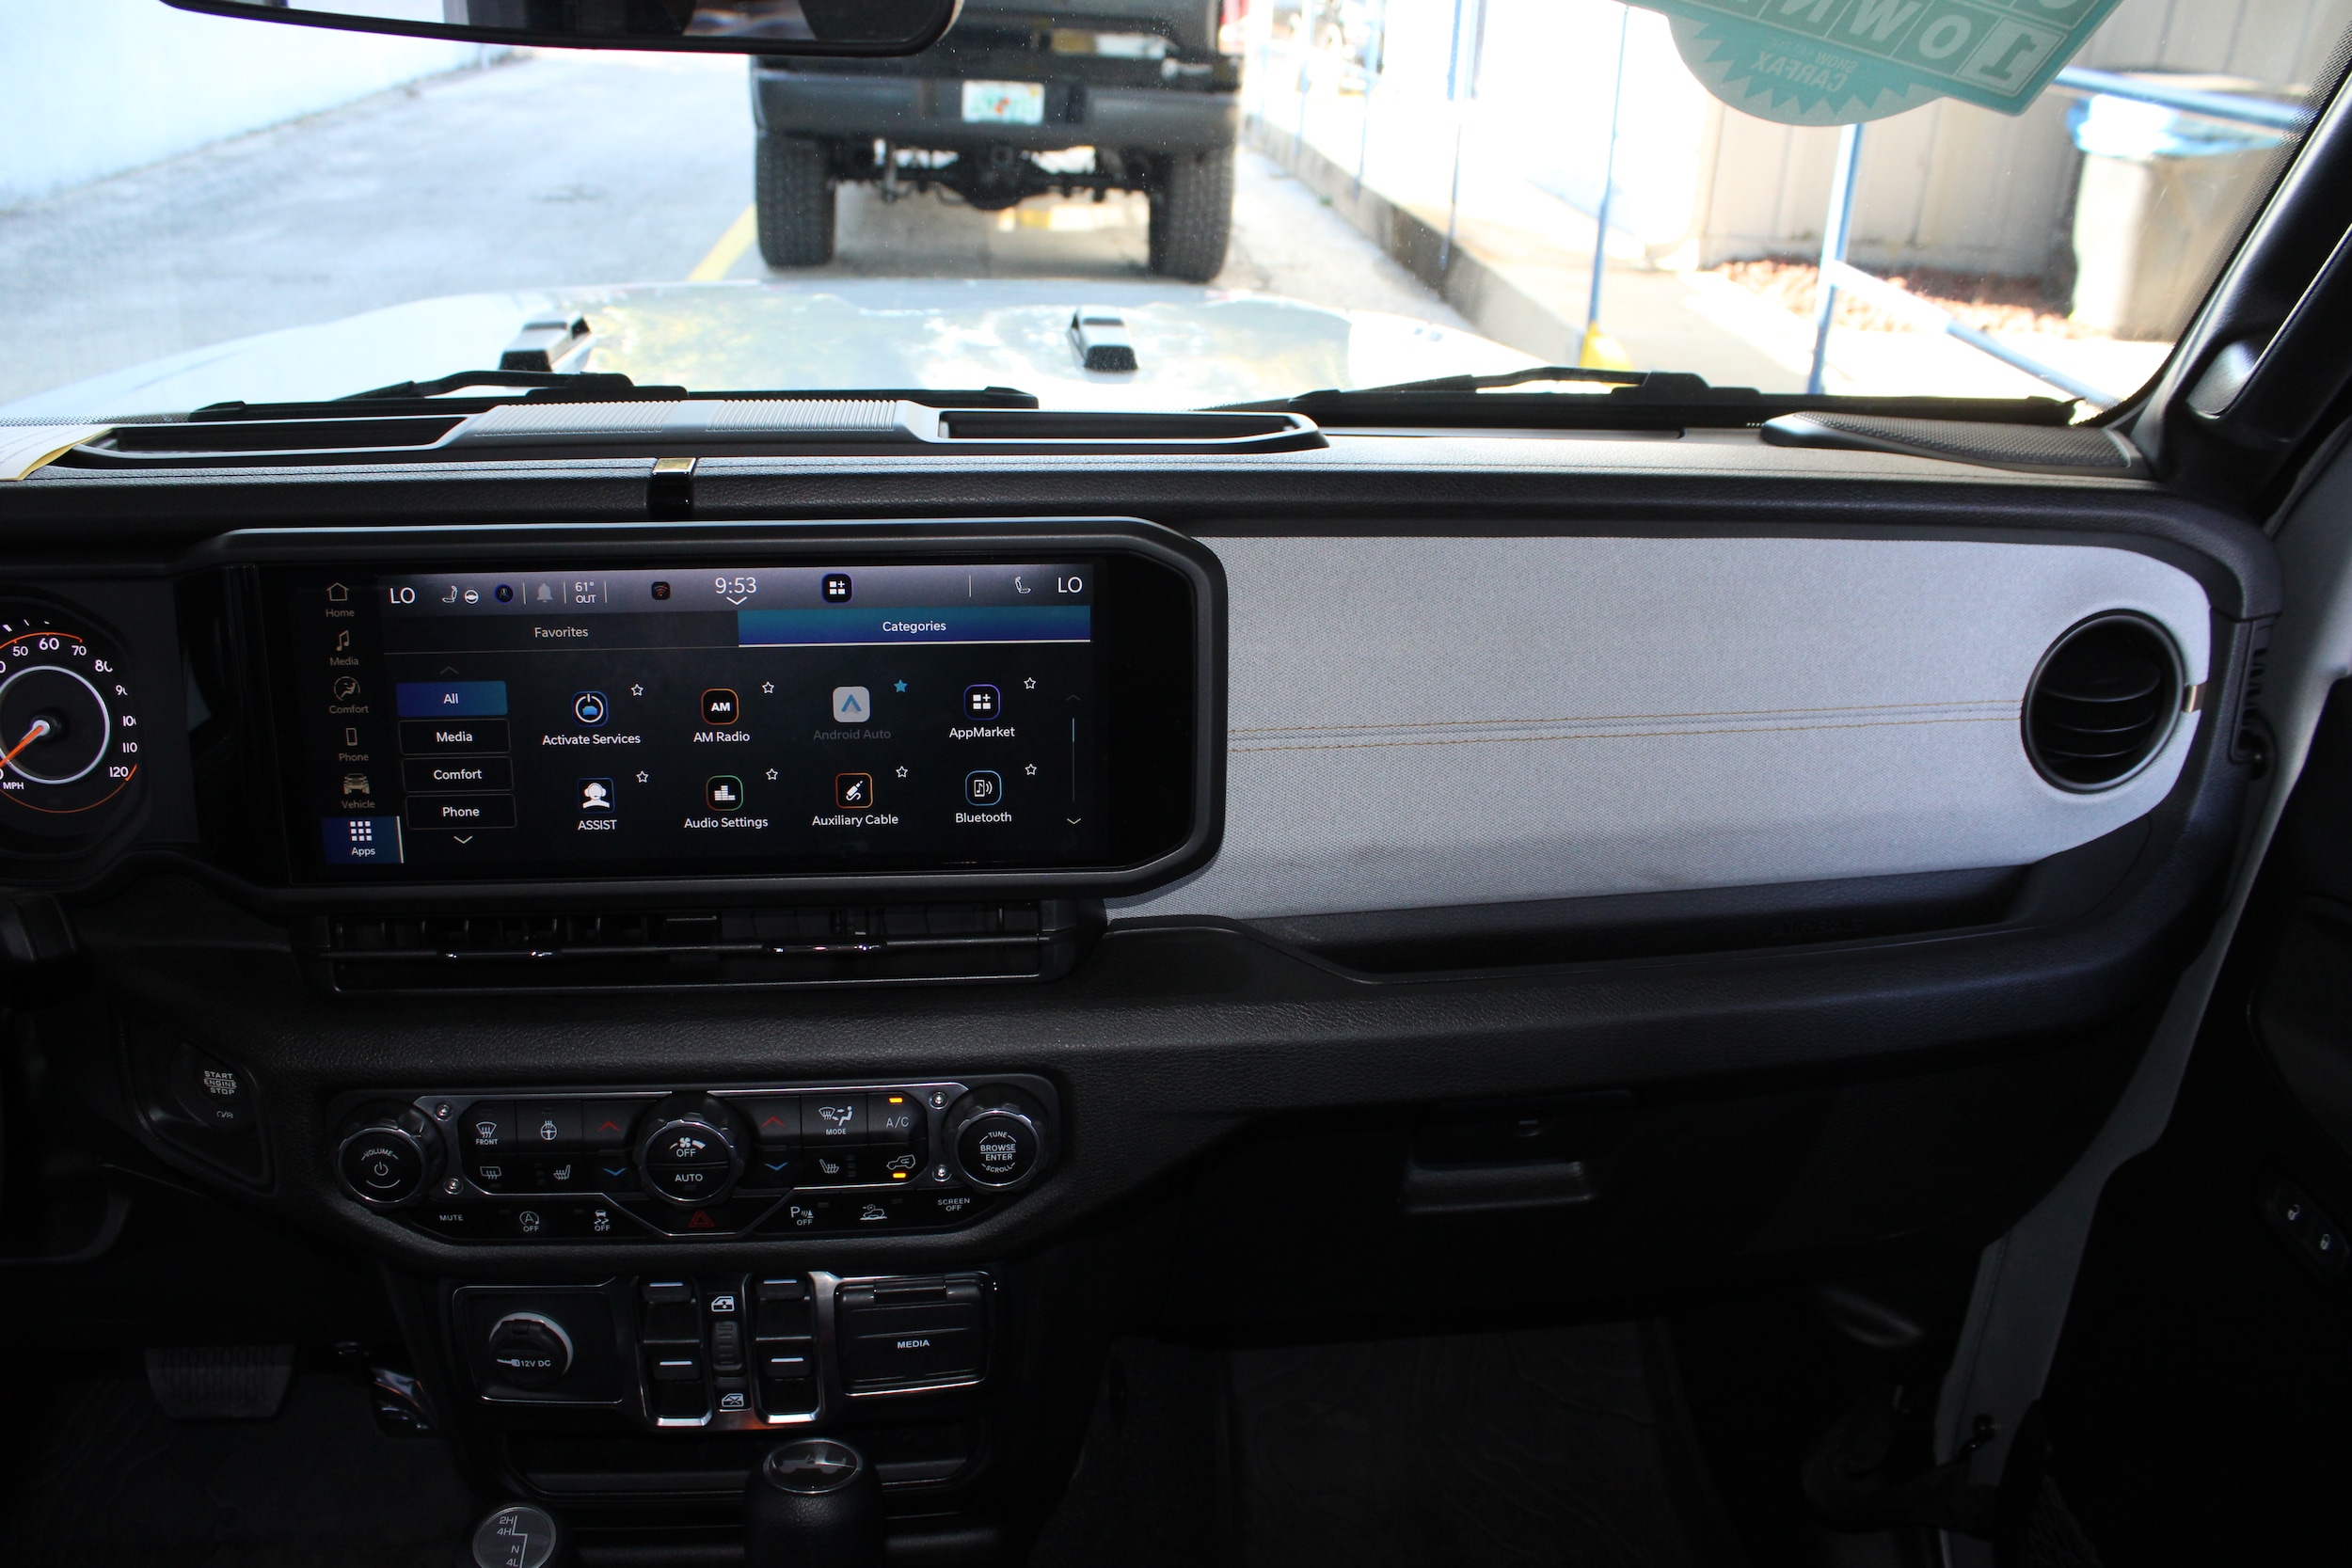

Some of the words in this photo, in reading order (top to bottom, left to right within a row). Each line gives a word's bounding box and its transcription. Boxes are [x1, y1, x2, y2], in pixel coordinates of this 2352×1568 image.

[714, 577, 757, 595] 9:53
[1057, 576, 1083, 594] LO
[389, 587, 416, 605] LO
[575, 594, 597, 604] OUT
[325, 608, 356, 618] Home
[533, 626, 589, 639] Favorites
[882, 620, 946, 634] Categories
[39, 638, 61, 652] 60
[71, 644, 87, 657] 70
[12, 645, 29, 657] 50
[329, 656, 359, 666] Media
[443, 692, 459, 705] All
[328, 704, 370, 715] Comfort
[710, 702, 731, 712] AM
[122, 715, 137, 727] 10
[436, 731, 473, 743] Media
[692, 731, 714, 743] AM
[716, 730, 751, 742] Radio
[813, 728, 861, 740] Android
[862, 729, 892, 739] Auto
[948, 725, 1016, 740] AppMarket
[542, 734, 592, 746] Activate
[593, 733, 643, 746] Services
[122, 741, 138, 753] 110
[338, 752, 370, 762] Phone
[109, 766, 129, 778] 120
[433, 768, 483, 781] Comfort
[2, 781, 24, 790] MPH
[341, 800, 375, 809] Vehicle
[442, 806, 481, 817] Phone
[683, 816, 720, 829] Audio
[721, 816, 769, 830] Settings
[811, 815, 864, 828] Auxiliary
[865, 814, 899, 825] Cable
[955, 811, 1012, 824] Bluetooth
[577, 819, 618, 831] ASSIST
[351, 847, 376, 858] Apps
[204, 1070, 233, 1079] START
[204, 1079, 237, 1087] ENGINE
[885, 1116, 910, 1129] A/C
[825, 1127, 847, 1135] MODE
[988, 1131, 1008, 1139] TUNE
[363, 1148, 393, 1158] VOLUME
[675, 1148, 696, 1158] OFF
[980, 1144, 1016, 1152] BROWSE
[985, 1153, 1013, 1162] ENTER
[675, 1173, 704, 1182] AUTO
[936, 1197, 971, 1207] SCREEN
[945, 1204, 962, 1212] OFF
[438, 1213, 464, 1222] MUTE
[796, 1216, 815, 1227] OFF
[522, 1225, 539, 1233] OFF
[594, 1222, 611, 1232] OFF
[897, 1338, 930, 1349] MEDIA
[500, 1516, 514, 1525] 2H
[511, 1545, 519, 1554] N
[506, 1559, 518, 1567] 4L
